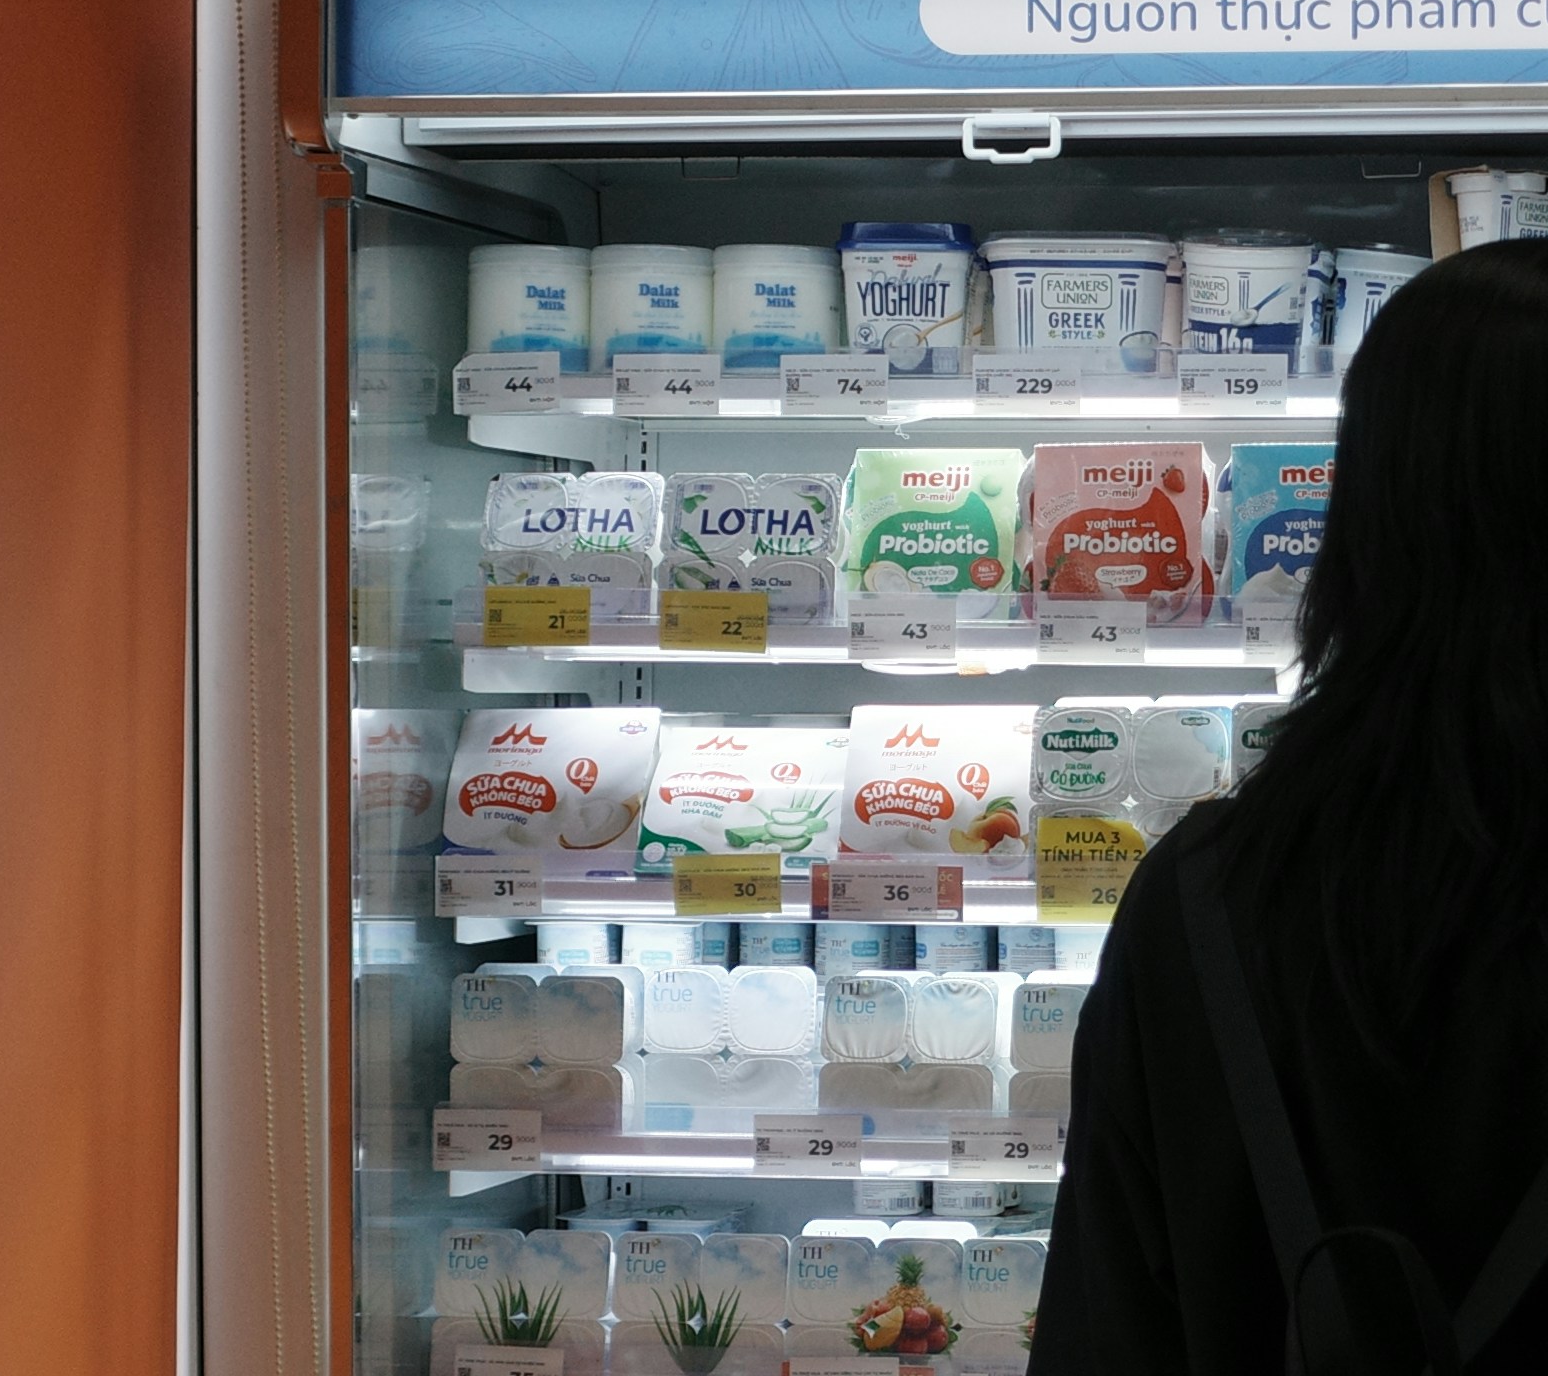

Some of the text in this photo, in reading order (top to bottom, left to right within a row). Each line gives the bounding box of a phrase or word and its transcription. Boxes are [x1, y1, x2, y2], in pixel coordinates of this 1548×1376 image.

[1045, 278, 1110, 291] FARMERS
[526, 287, 566, 302] Dalat
[856, 279, 948, 320] YOGHURT
[1055, 291, 1096, 305] UNION
[538, 301, 565, 311] Milk
[1048, 312, 1105, 329] GREEK
[504, 376, 530, 394] 44
[837, 378, 862, 395] 74
[1016, 377, 1052, 395] 229
[1225, 378, 1258, 396] 159
[902, 466, 971, 492] meiji
[1082, 460, 1152, 486] meiji
[523, 509, 635, 534] LOTHA
[700, 511, 815, 536] LOTHA
[880, 532, 988, 559] Probiotic
[1063, 532, 1177, 557] Probiotic
[721, 620, 742, 637] 22
[902, 623, 927, 641] 43
[1046, 734, 1116, 750] NutiMilk
[860, 781, 944, 804] SỮA CHUA
[866, 798, 941, 819] KHÔNG BÉO
[1065, 830, 1120, 845] MUA 3
[1042, 846, 1081, 863] TÍNH
[1087, 846, 1129, 863] TIỀN
[883, 885, 909, 902] 36
